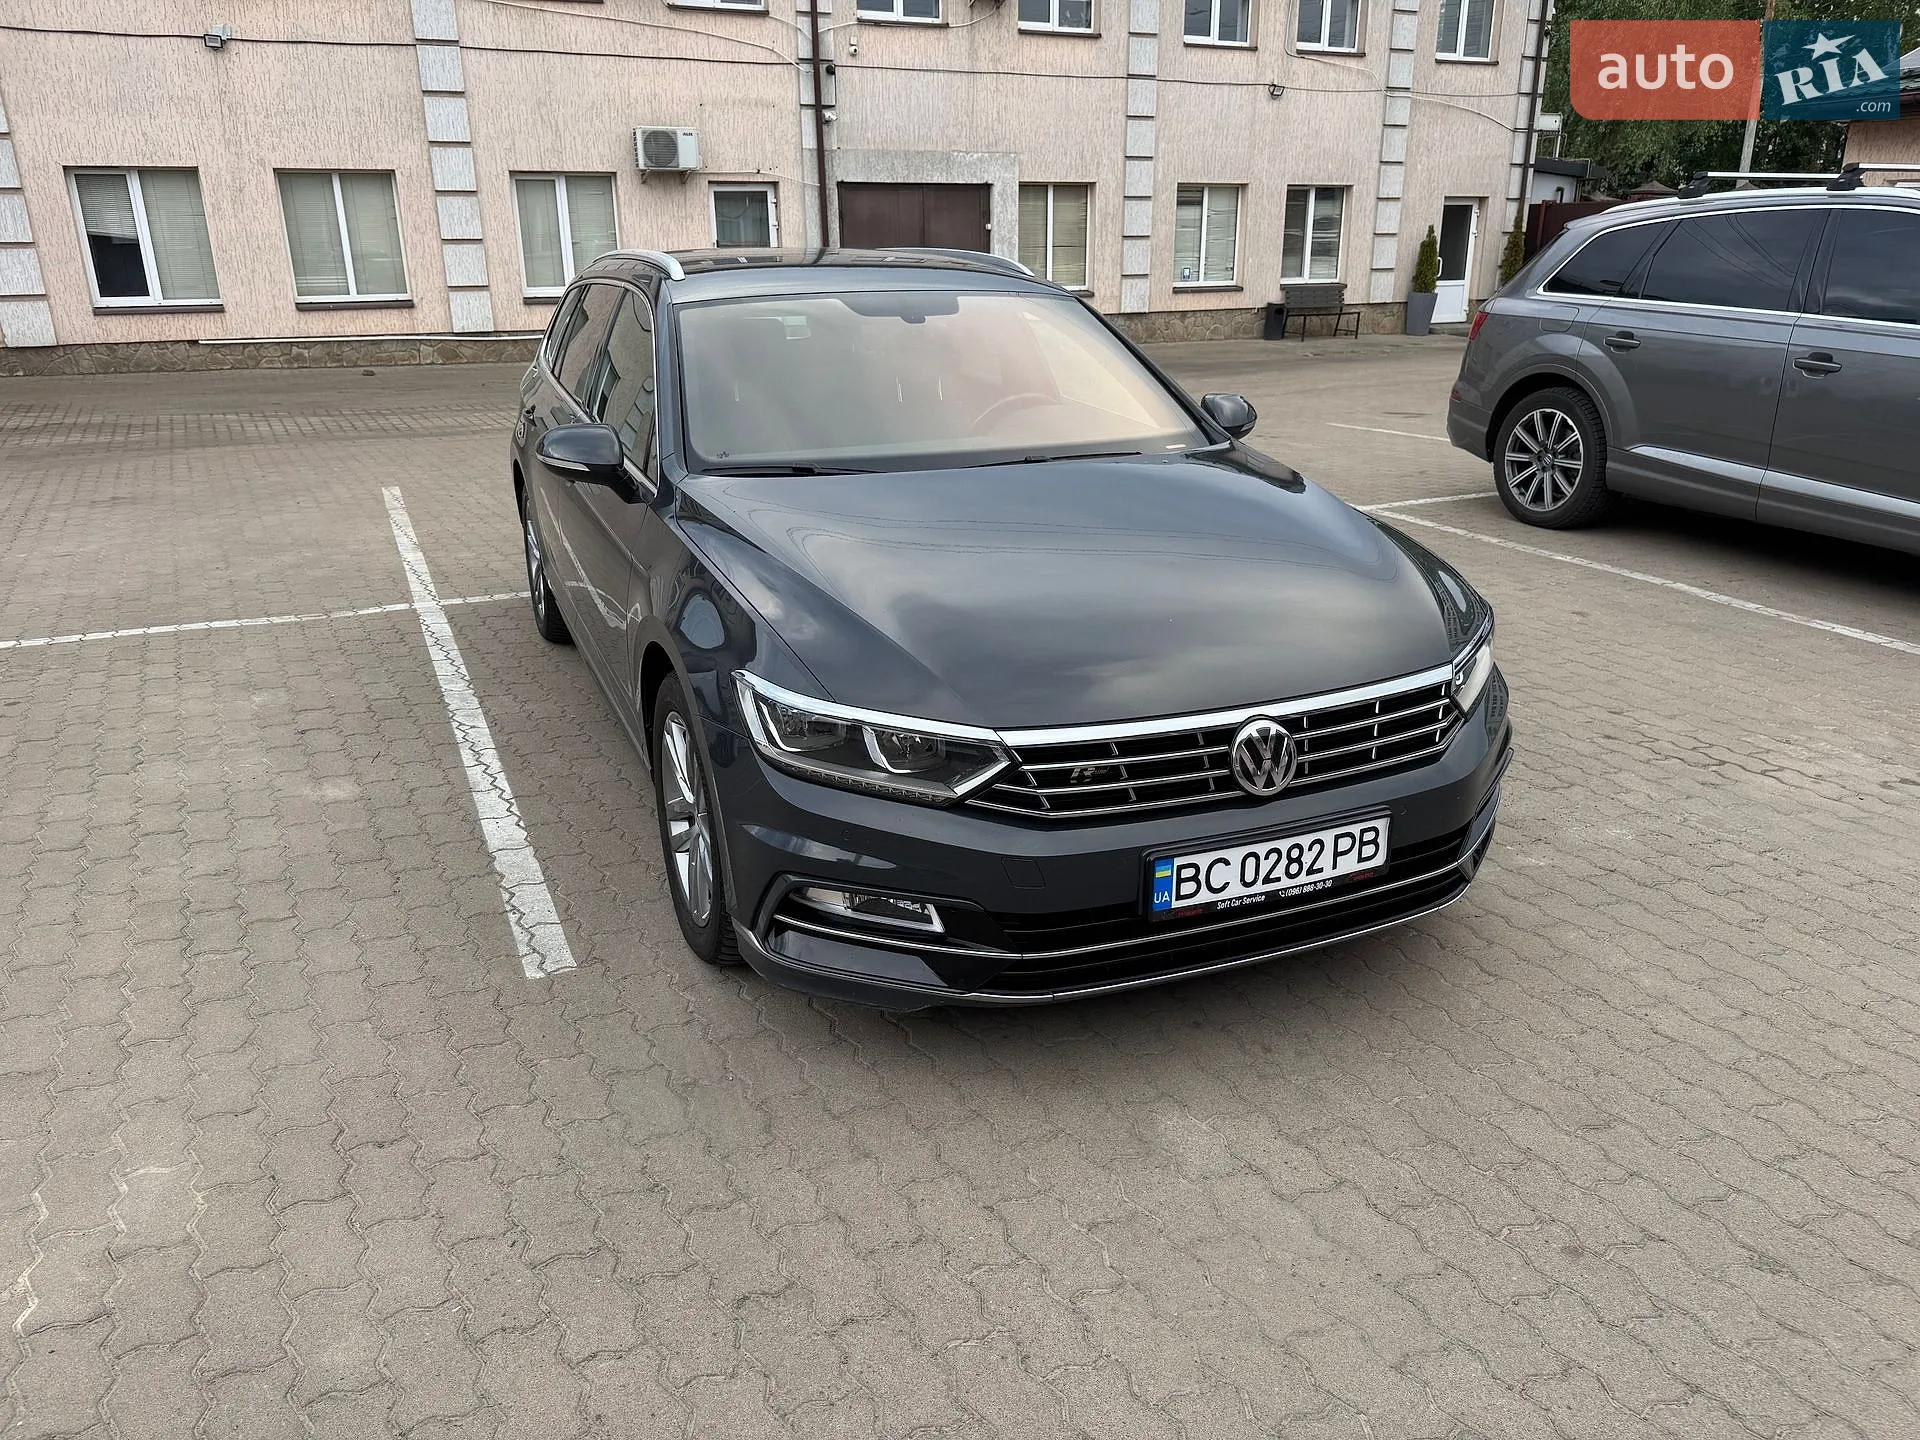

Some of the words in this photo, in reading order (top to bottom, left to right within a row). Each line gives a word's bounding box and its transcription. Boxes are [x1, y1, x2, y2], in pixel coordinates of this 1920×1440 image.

[1153, 891, 1170, 904] UA
[1231, 898, 1242, 907] Car
[1242, 894, 1265, 905] Service
